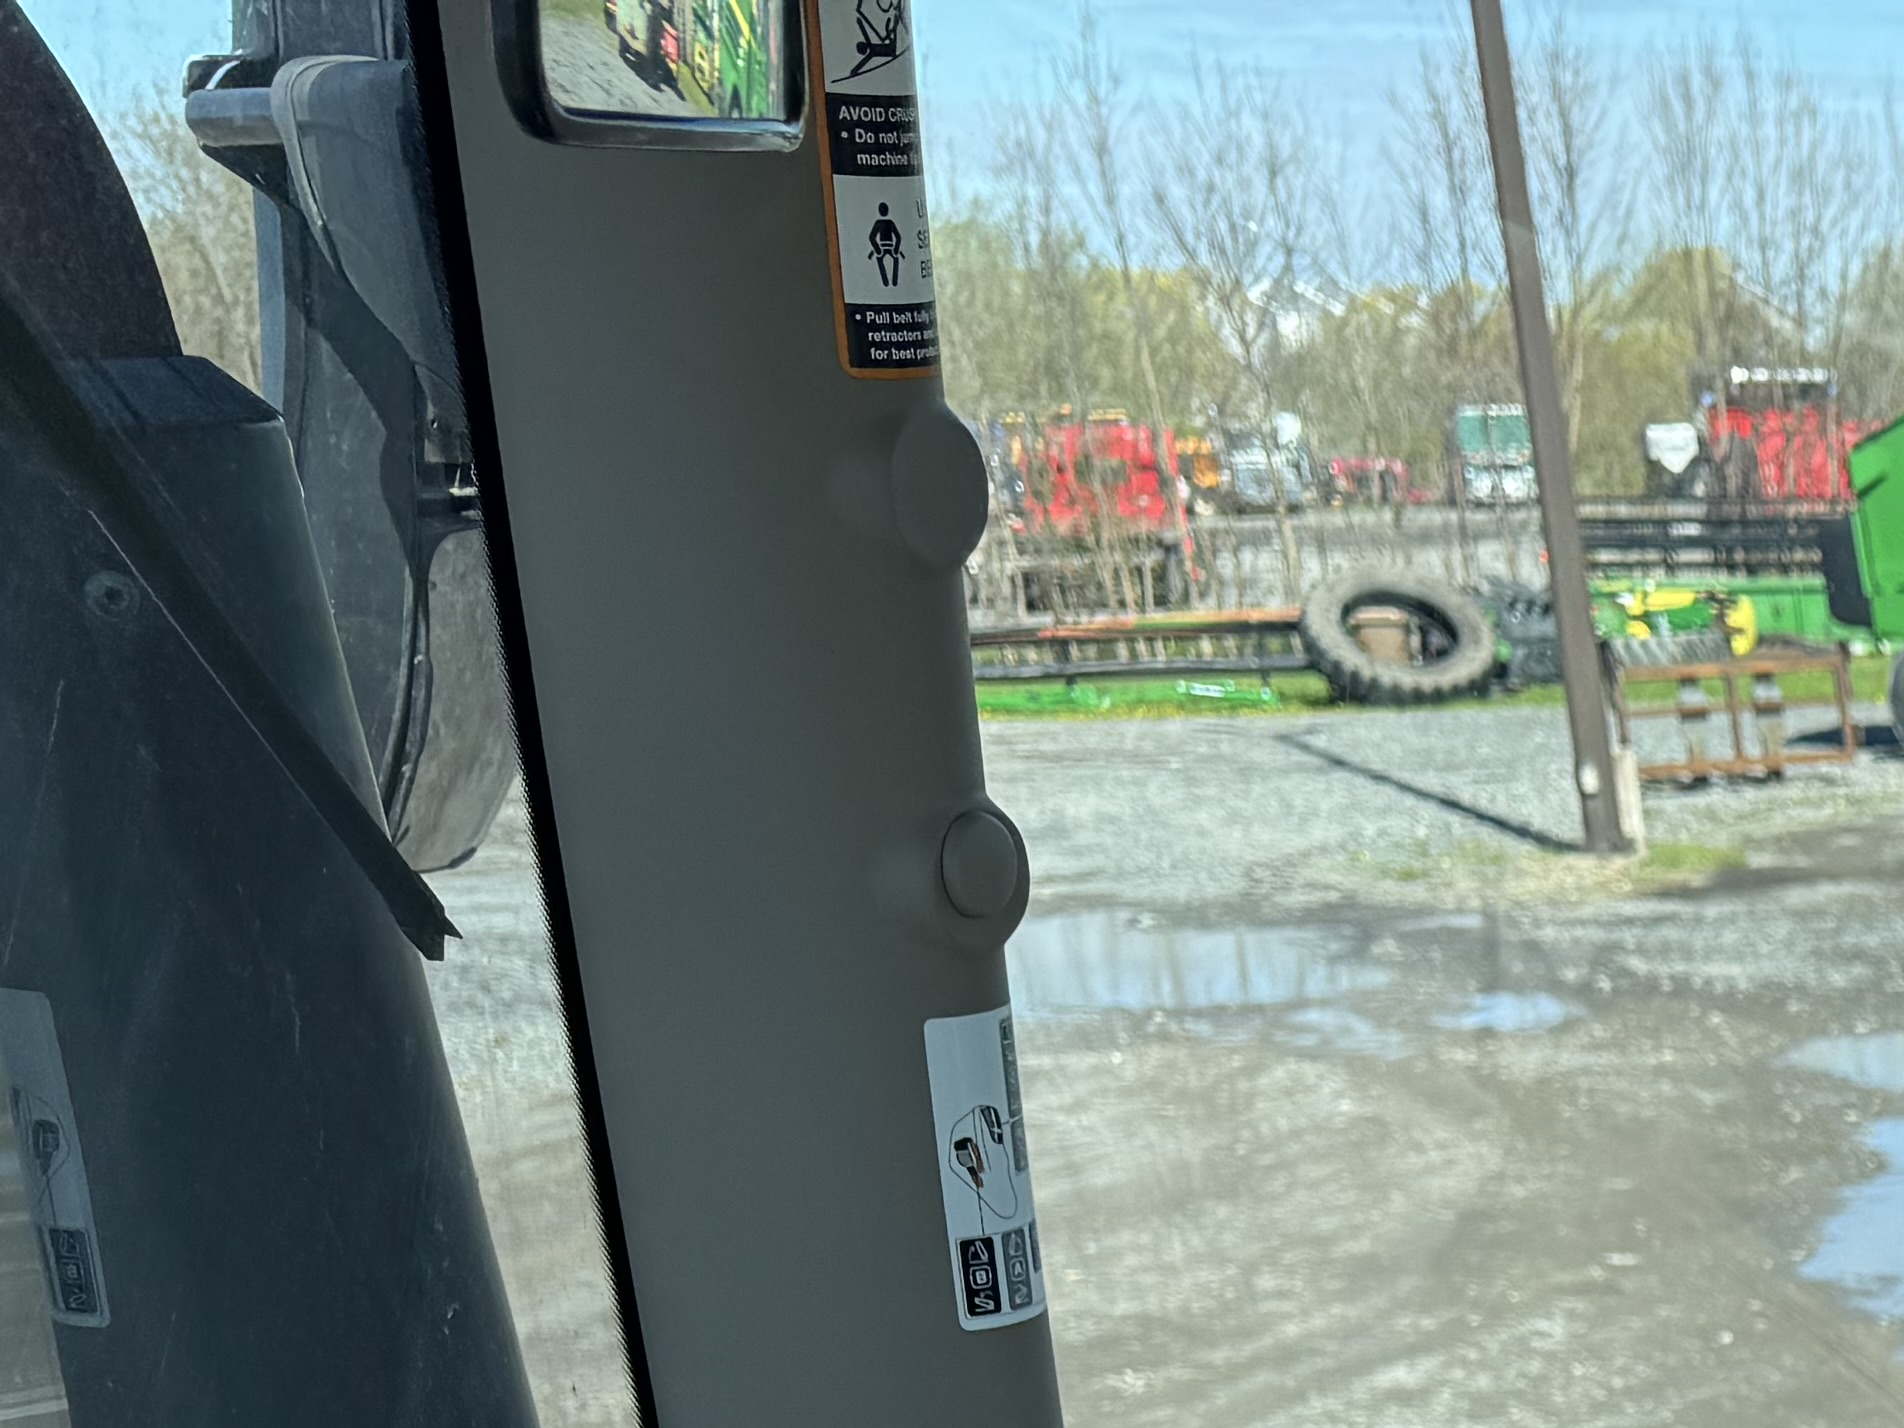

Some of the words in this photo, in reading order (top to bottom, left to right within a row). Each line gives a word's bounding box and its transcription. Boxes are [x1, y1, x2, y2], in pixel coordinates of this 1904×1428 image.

[839, 105, 885, 122] AVOID
[855, 128, 875, 143] Do
[879, 131, 898, 144] not
[857, 152, 908, 166] machine
[866, 311, 890, 324] Pull
[893, 312, 912, 323] belt
[868, 331, 922, 342] retractors
[870, 347, 888, 360] for
[891, 348, 916, 360] best
